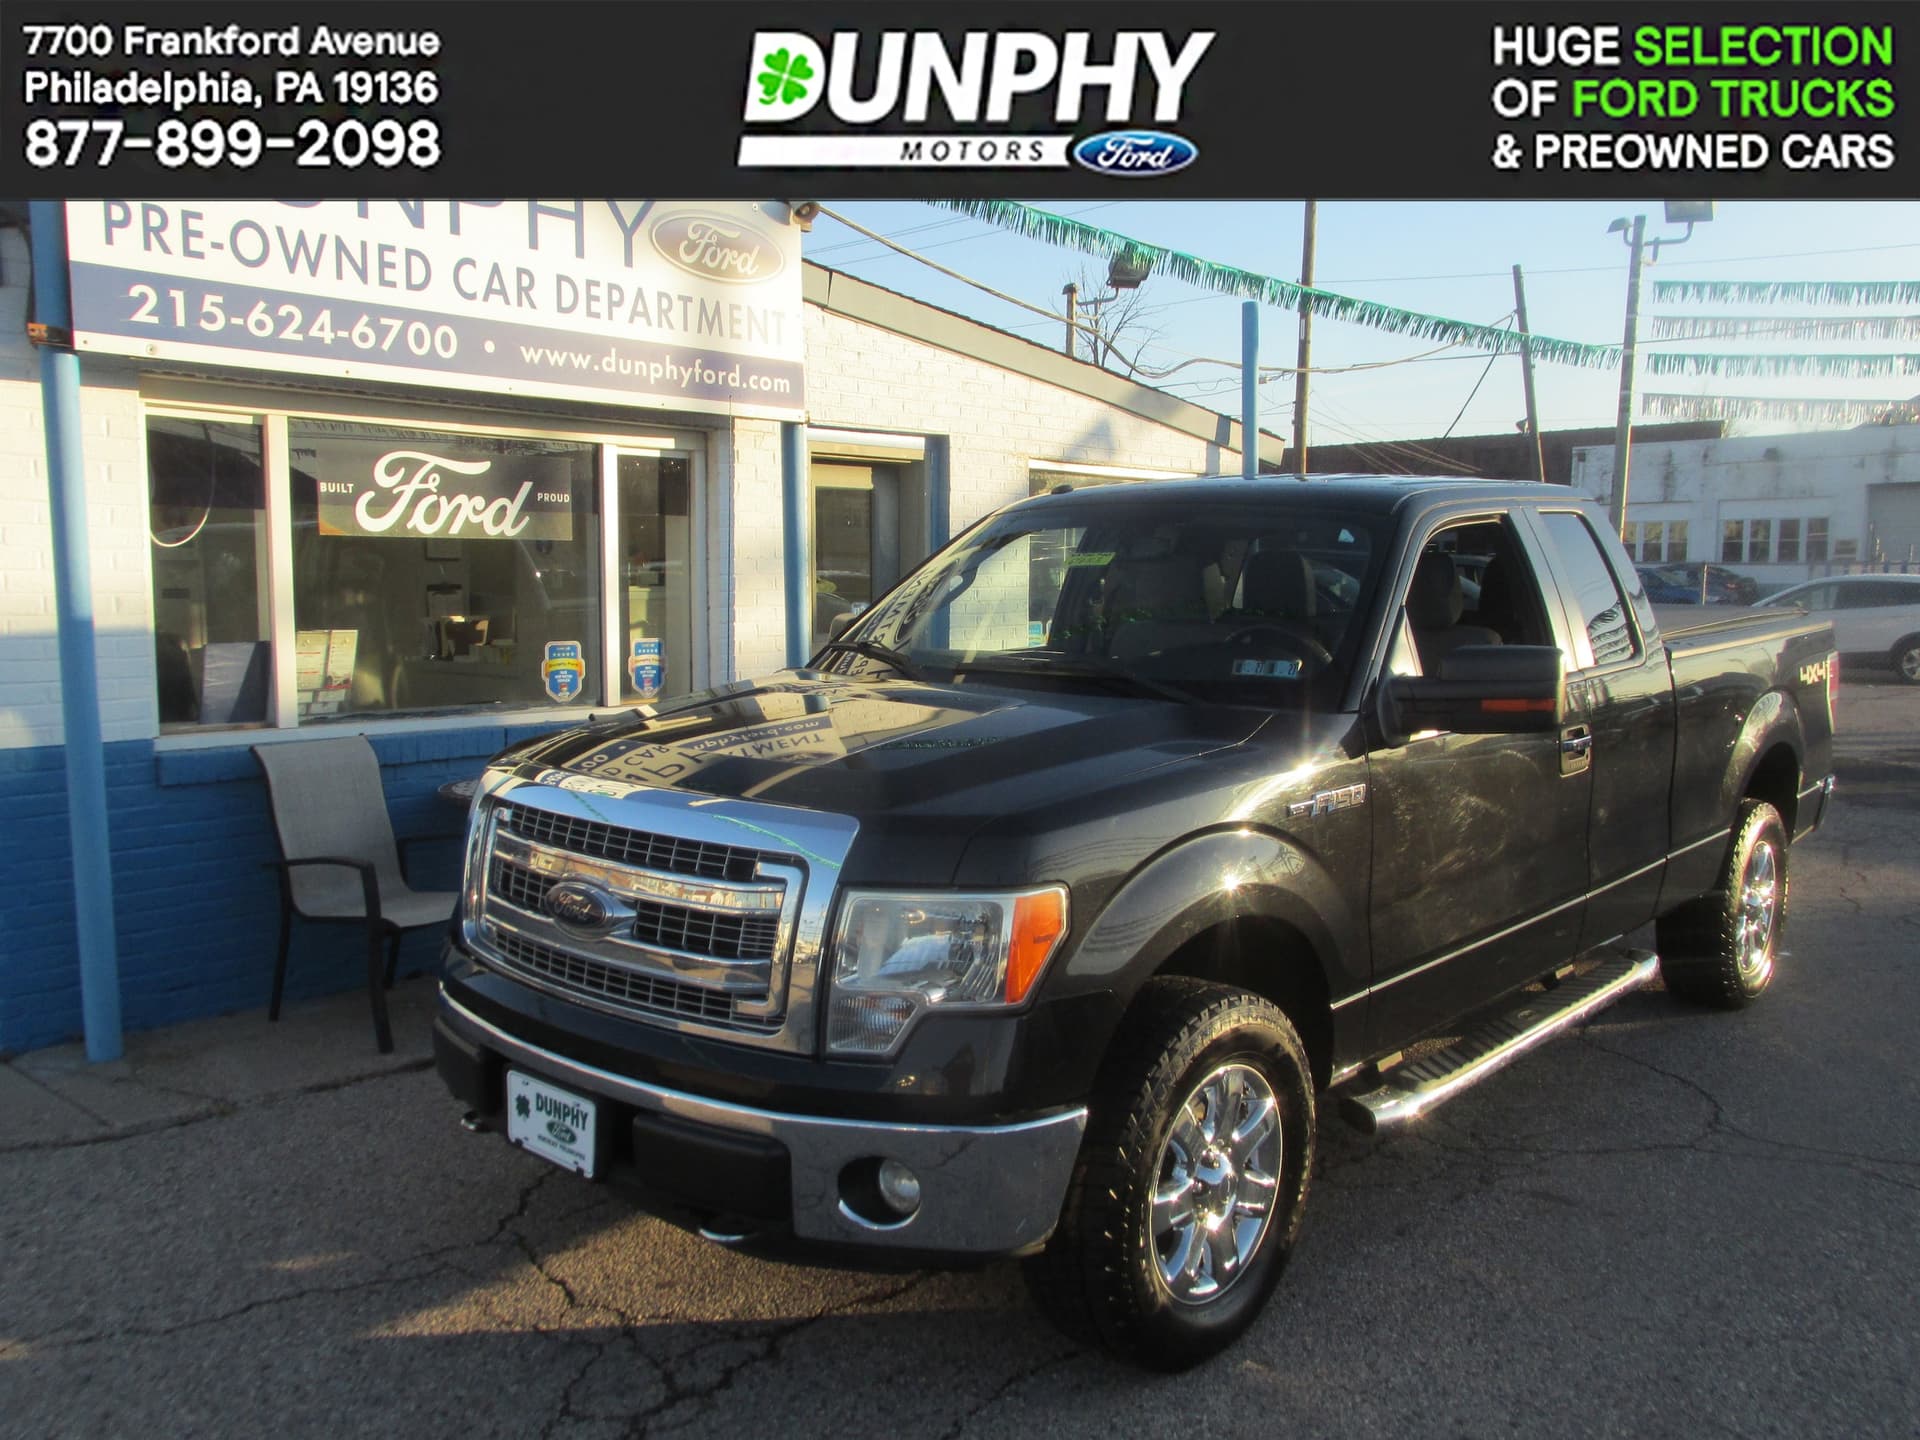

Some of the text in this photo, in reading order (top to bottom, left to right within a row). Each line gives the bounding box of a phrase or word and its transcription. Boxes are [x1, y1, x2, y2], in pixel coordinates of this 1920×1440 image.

[103, 201, 784, 344] PRE-OWNED CAR DEPARTMENT
[680, 221, 759, 274] Ford
[128, 284, 790, 393] 215-624-6700 www.dunphyford.com
[320, 450, 571, 537] BUILT Ford PROUD
[535, 1092, 589, 1131] DUNPHY
